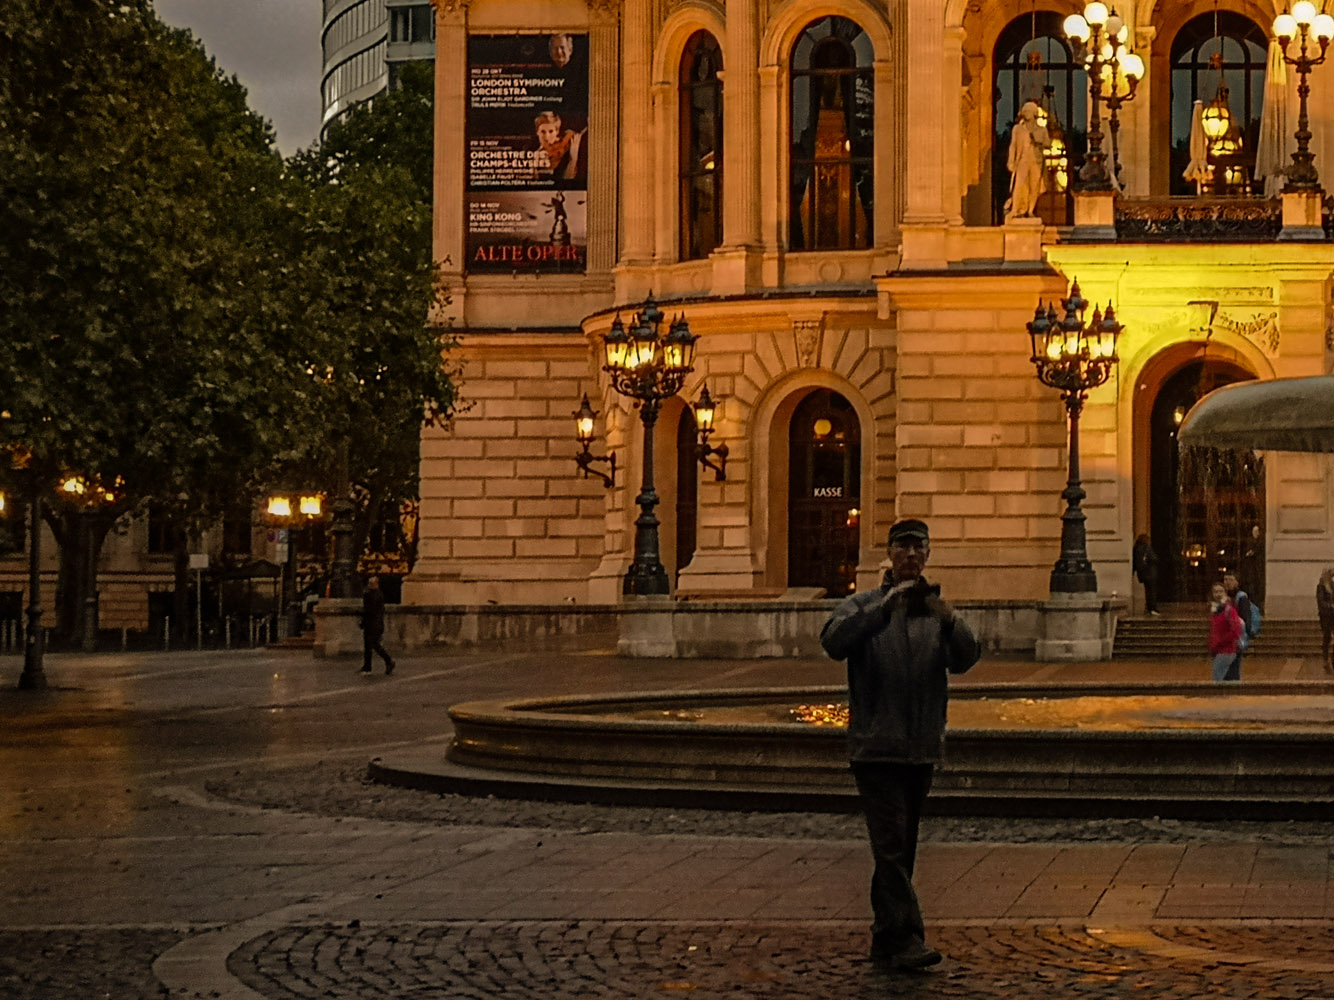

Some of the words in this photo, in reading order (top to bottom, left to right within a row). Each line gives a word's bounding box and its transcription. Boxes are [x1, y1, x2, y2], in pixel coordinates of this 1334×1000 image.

[471, 78, 512, 87] LONDON
[513, 78, 565, 87] SYMPHONY
[471, 87, 528, 96] ORCHESTRA
[470, 150, 525, 159] ORCHESTRE
[469, 212, 493, 221] KING
[494, 212, 522, 221] KONG
[474, 245, 524, 261] ALTE
[527, 244, 579, 261] OPER
[813, 486, 843, 497] KASSE
